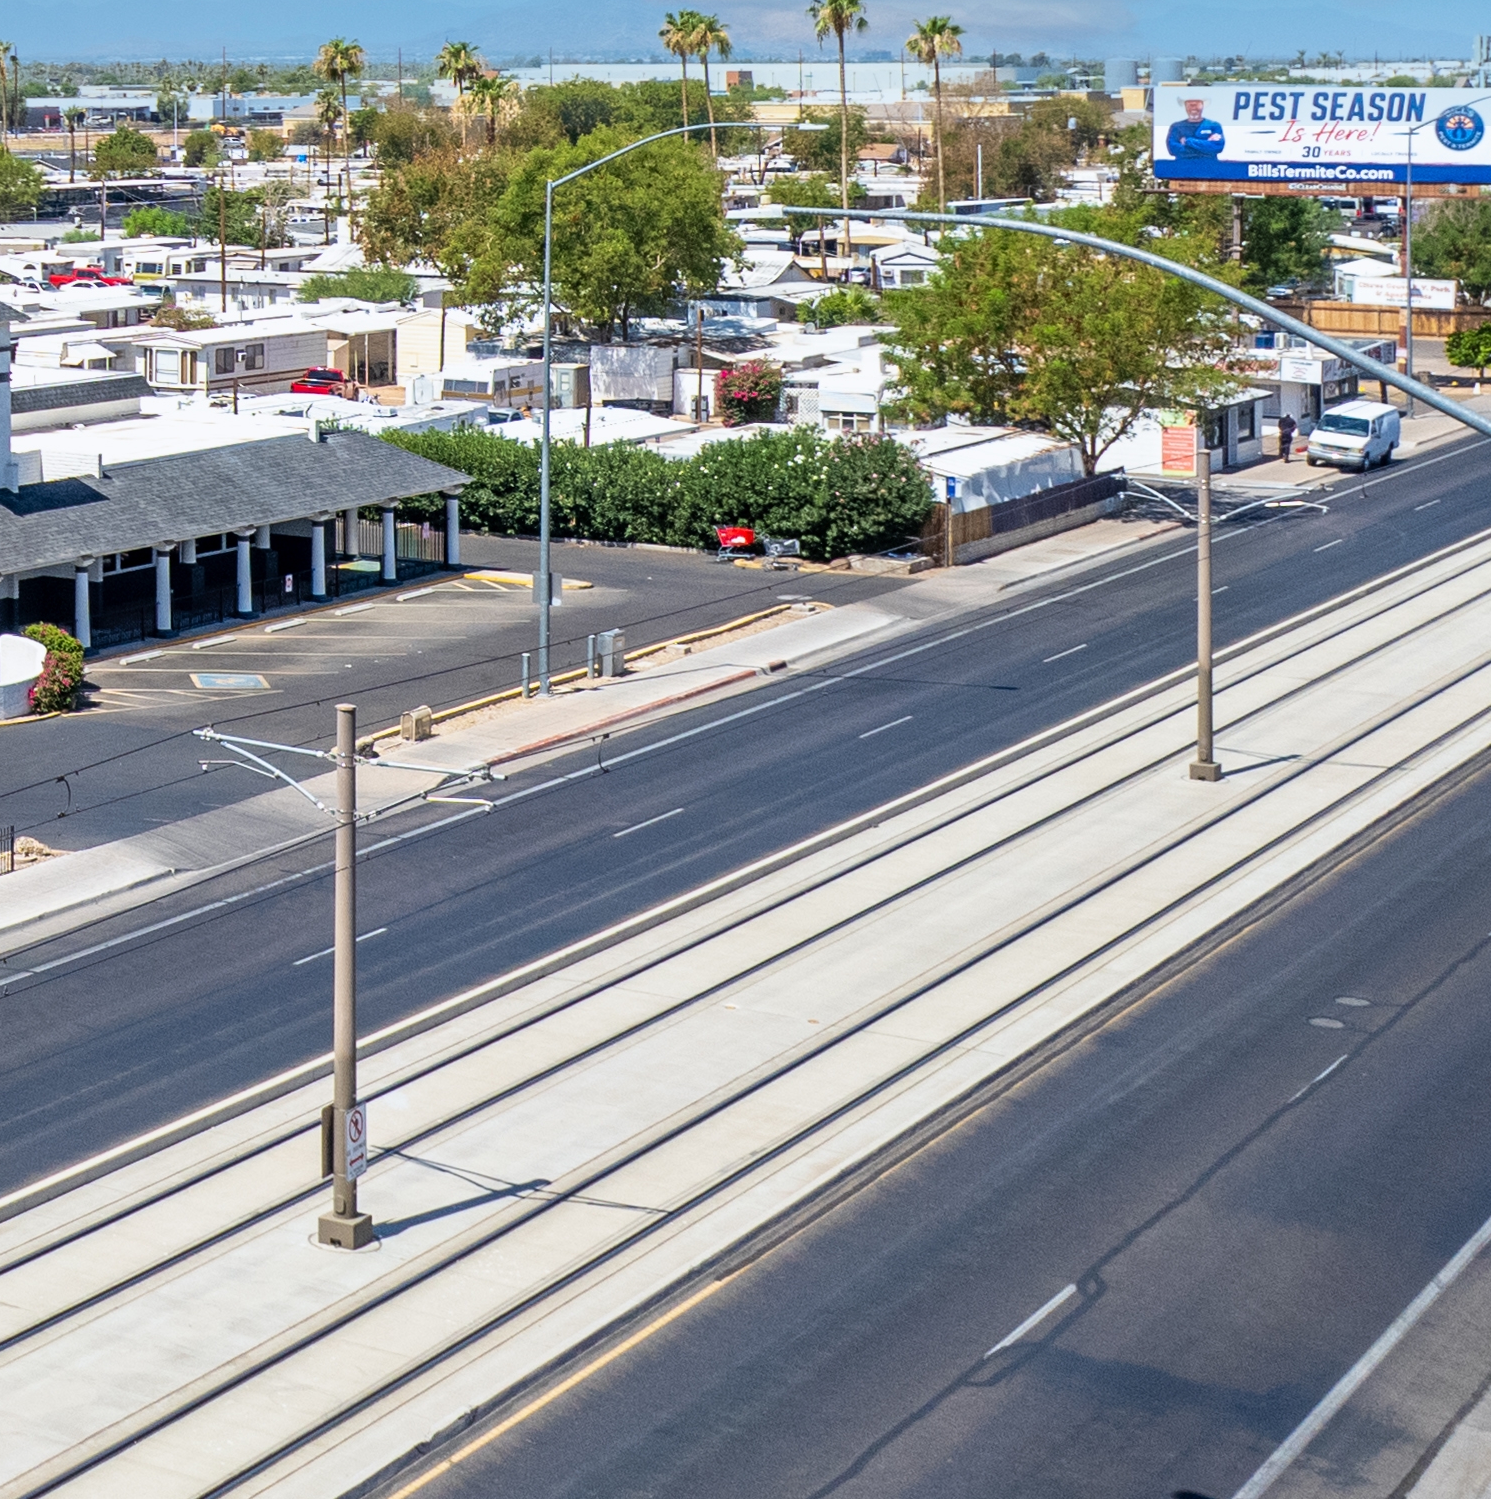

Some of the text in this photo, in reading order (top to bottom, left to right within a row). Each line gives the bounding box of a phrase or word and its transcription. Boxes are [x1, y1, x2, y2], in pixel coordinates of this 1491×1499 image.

[1232, 91, 1427, 122] PEST SEASON
[1278, 119, 1381, 144] Is Here!
[1302, 146, 1321, 158] 30
[1248, 164, 1394, 180] BillsTermiteCo.com
